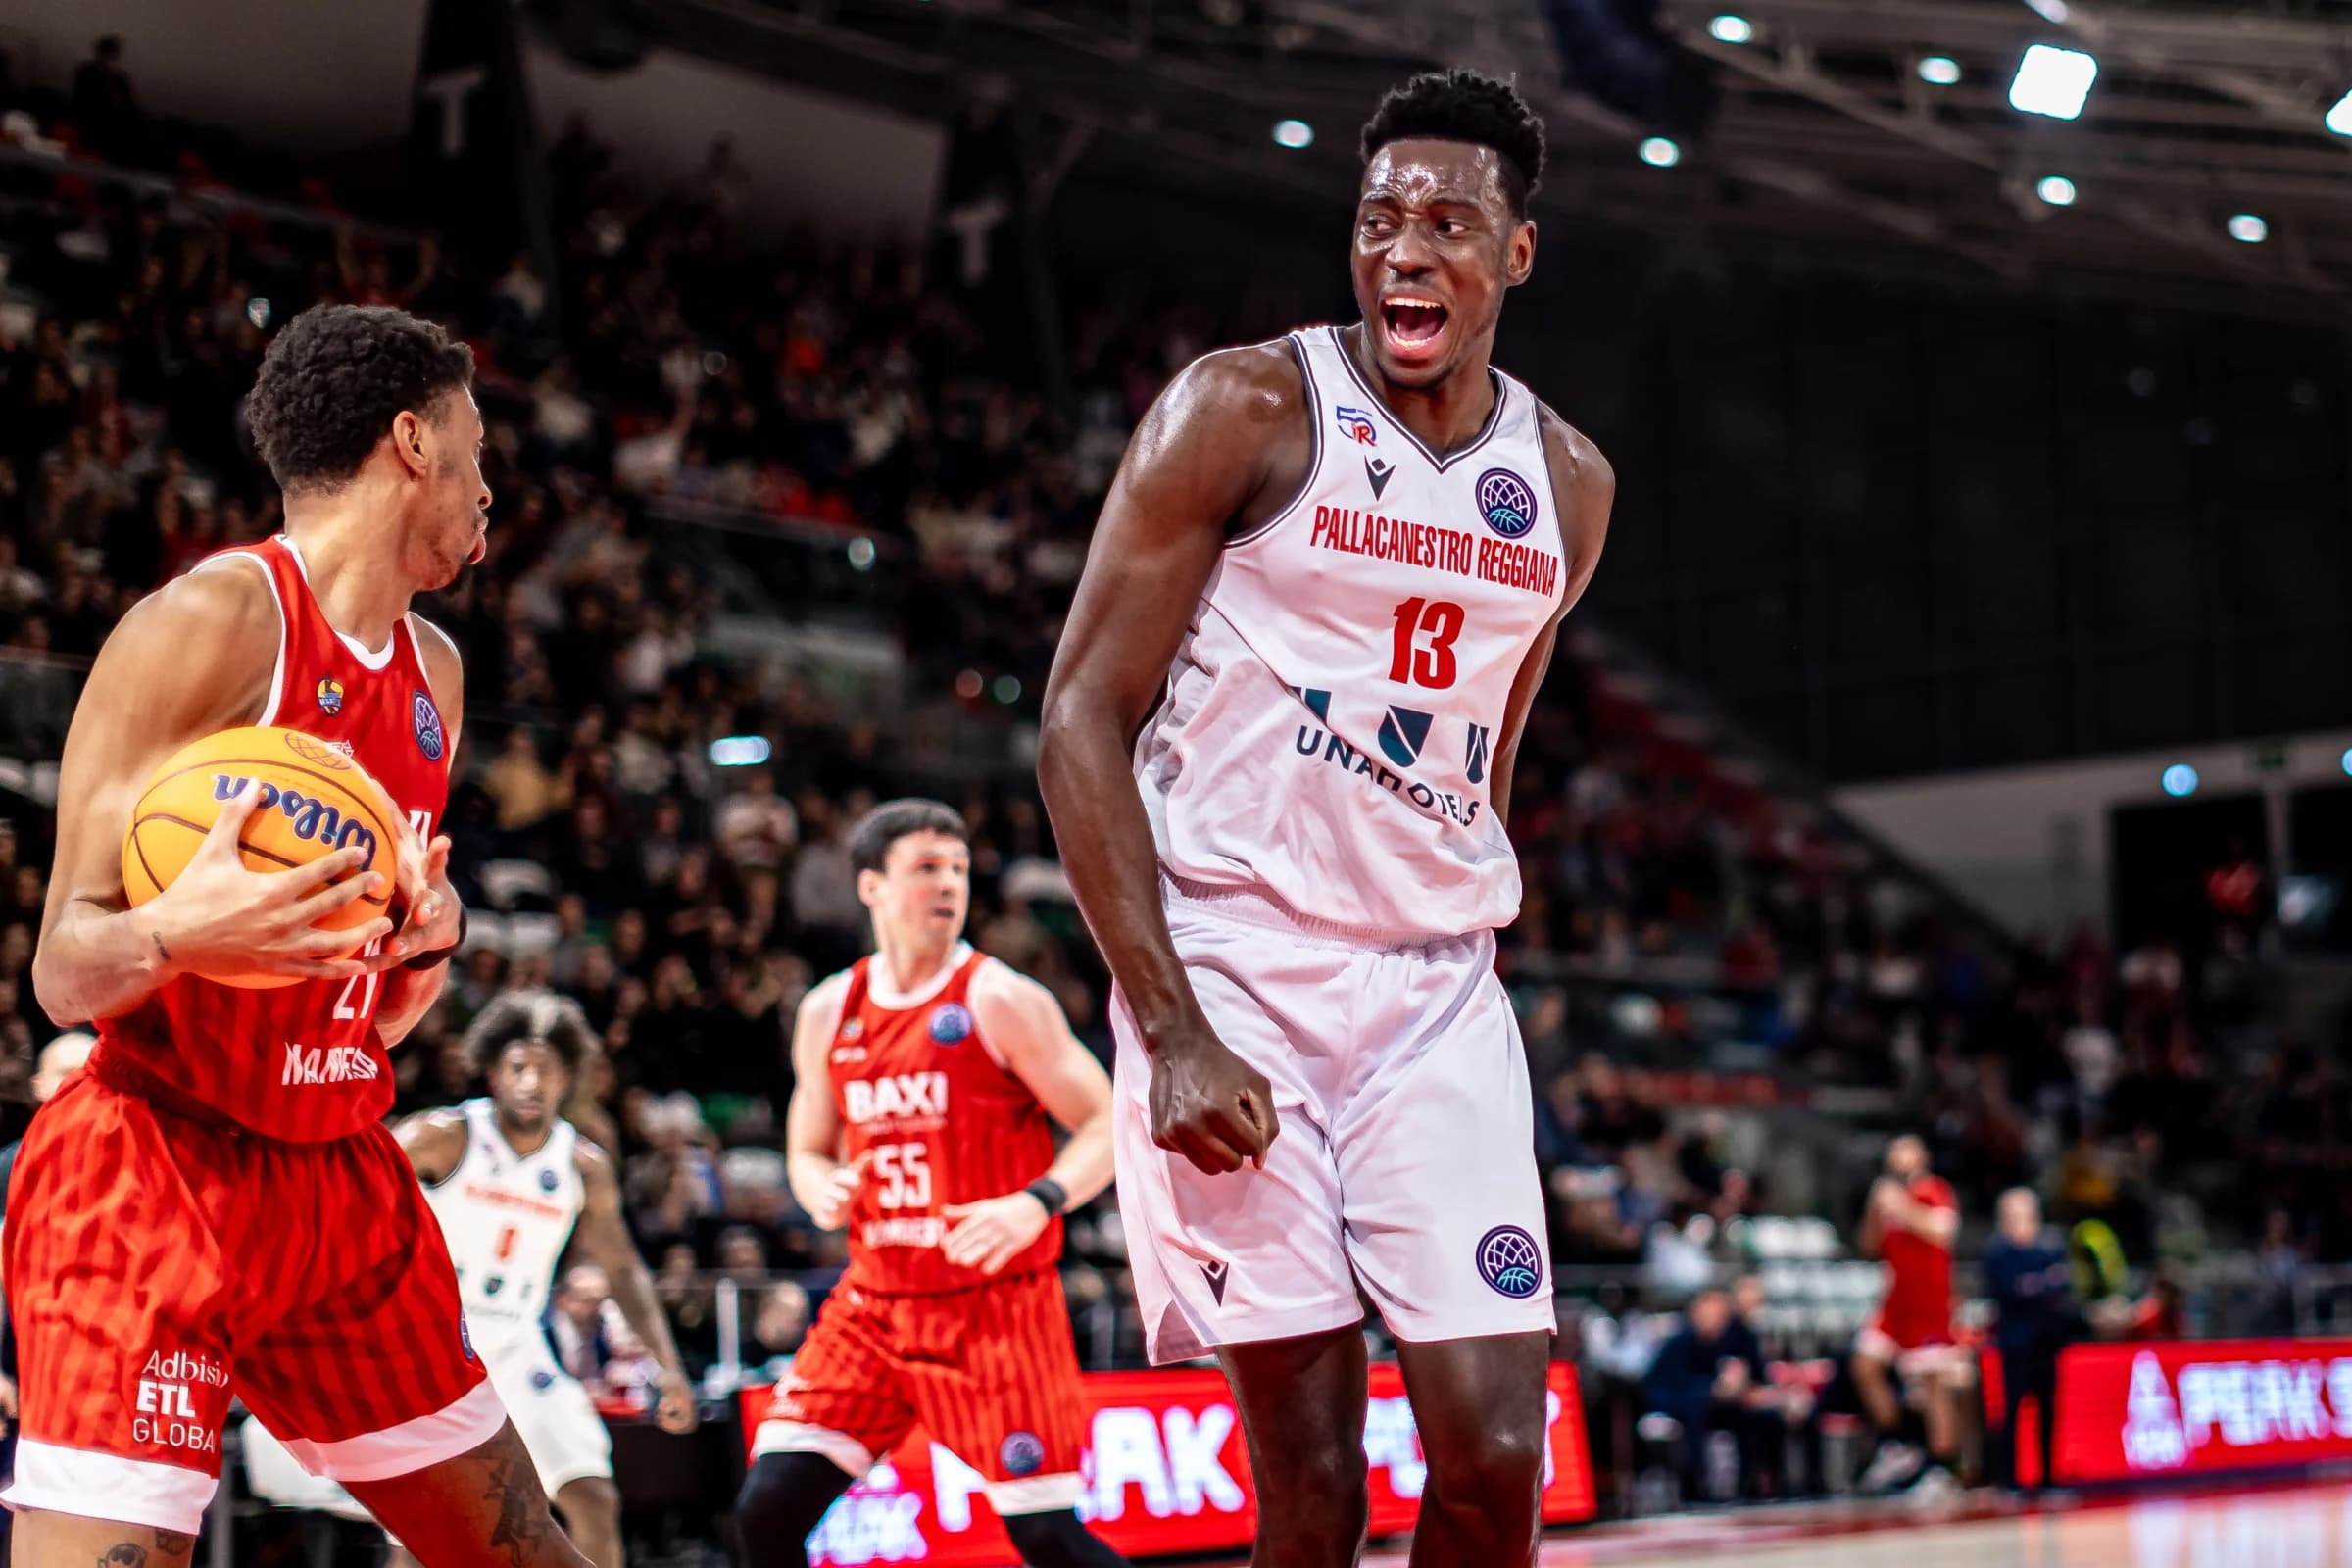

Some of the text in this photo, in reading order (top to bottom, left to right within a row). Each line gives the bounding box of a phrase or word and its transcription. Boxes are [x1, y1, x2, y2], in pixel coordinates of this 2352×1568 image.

[1309, 505, 1558, 598] PALLACANESTRO REGGIANA
[1388, 596, 1465, 690] 13
[213, 773, 377, 872] Wilson
[844, 1071, 949, 1124] BAXI
[873, 1142, 931, 1209] 55
[136, 1379, 196, 1418] ETL
